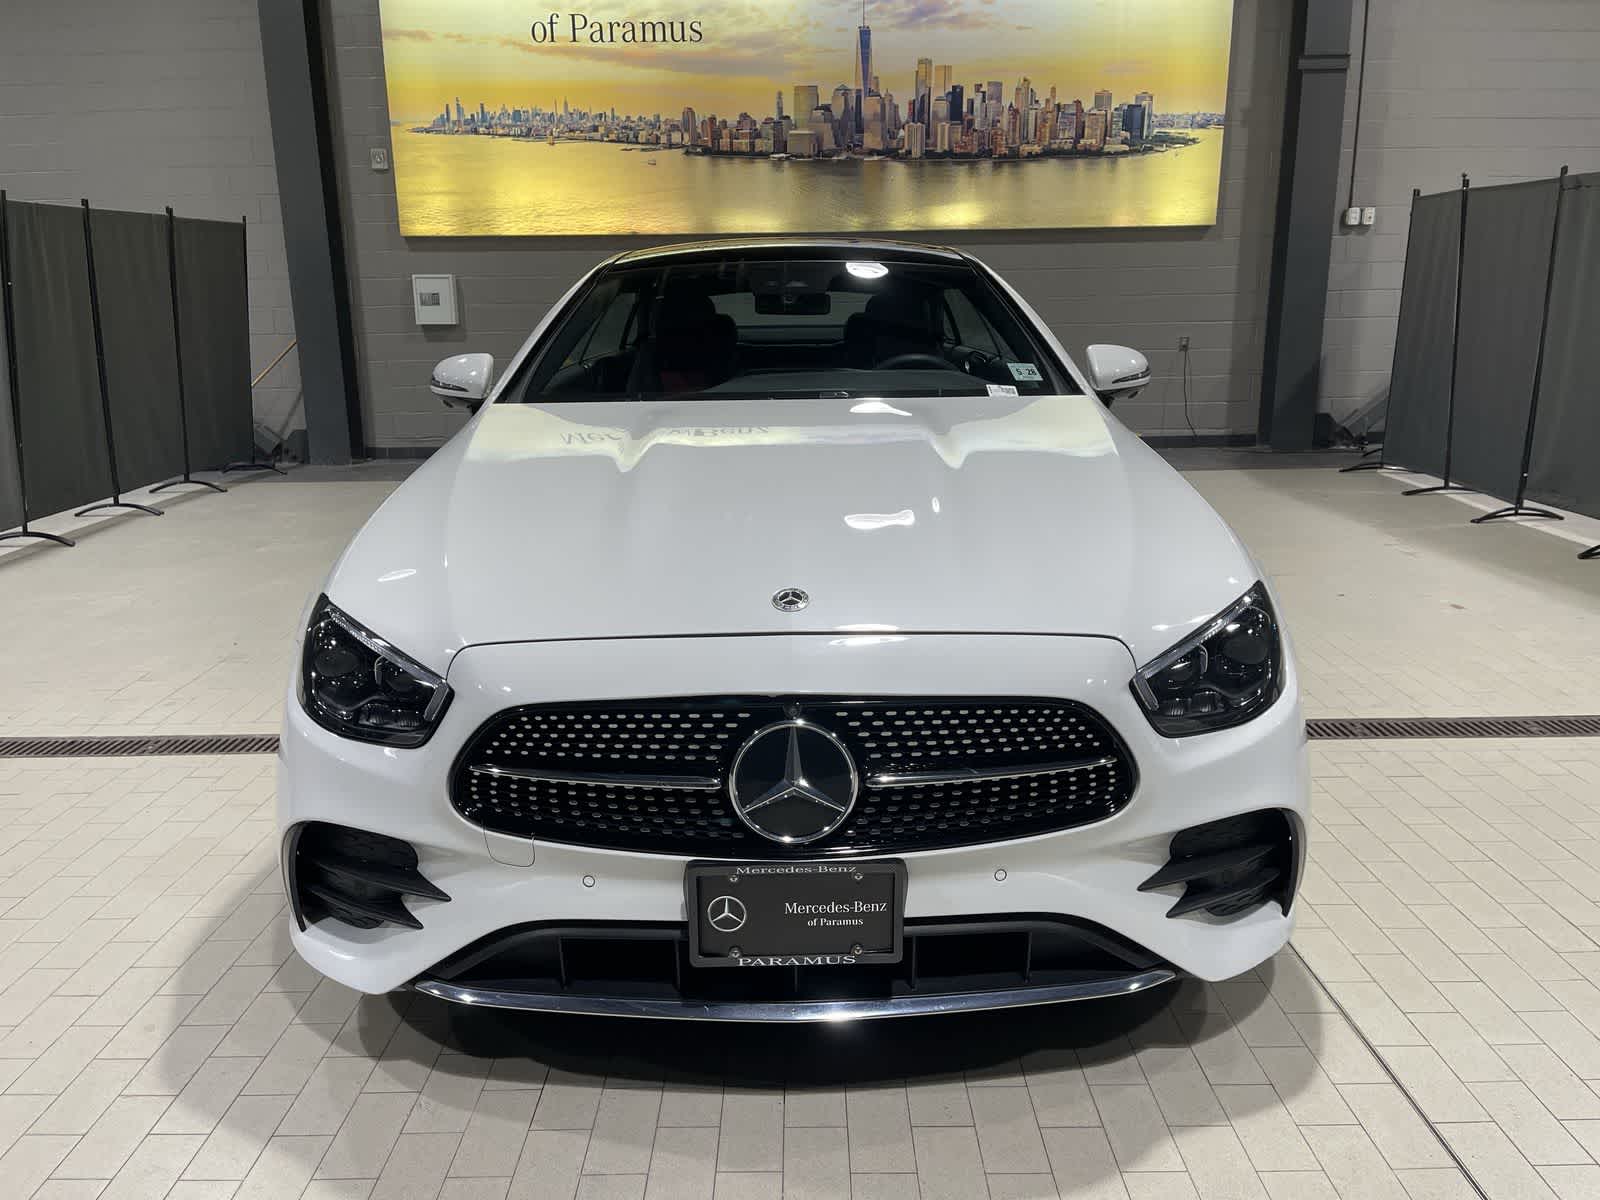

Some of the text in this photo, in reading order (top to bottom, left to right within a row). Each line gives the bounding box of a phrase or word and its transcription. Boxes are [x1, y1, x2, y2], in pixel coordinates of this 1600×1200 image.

[531, 13, 703, 43] of Paramus
[735, 865, 857, 875] Mercedes-Benz
[784, 900, 887, 914] Mercedes-Benz
[807, 917, 864, 927] of Paramus
[738, 955, 857, 966] PARAMUS
